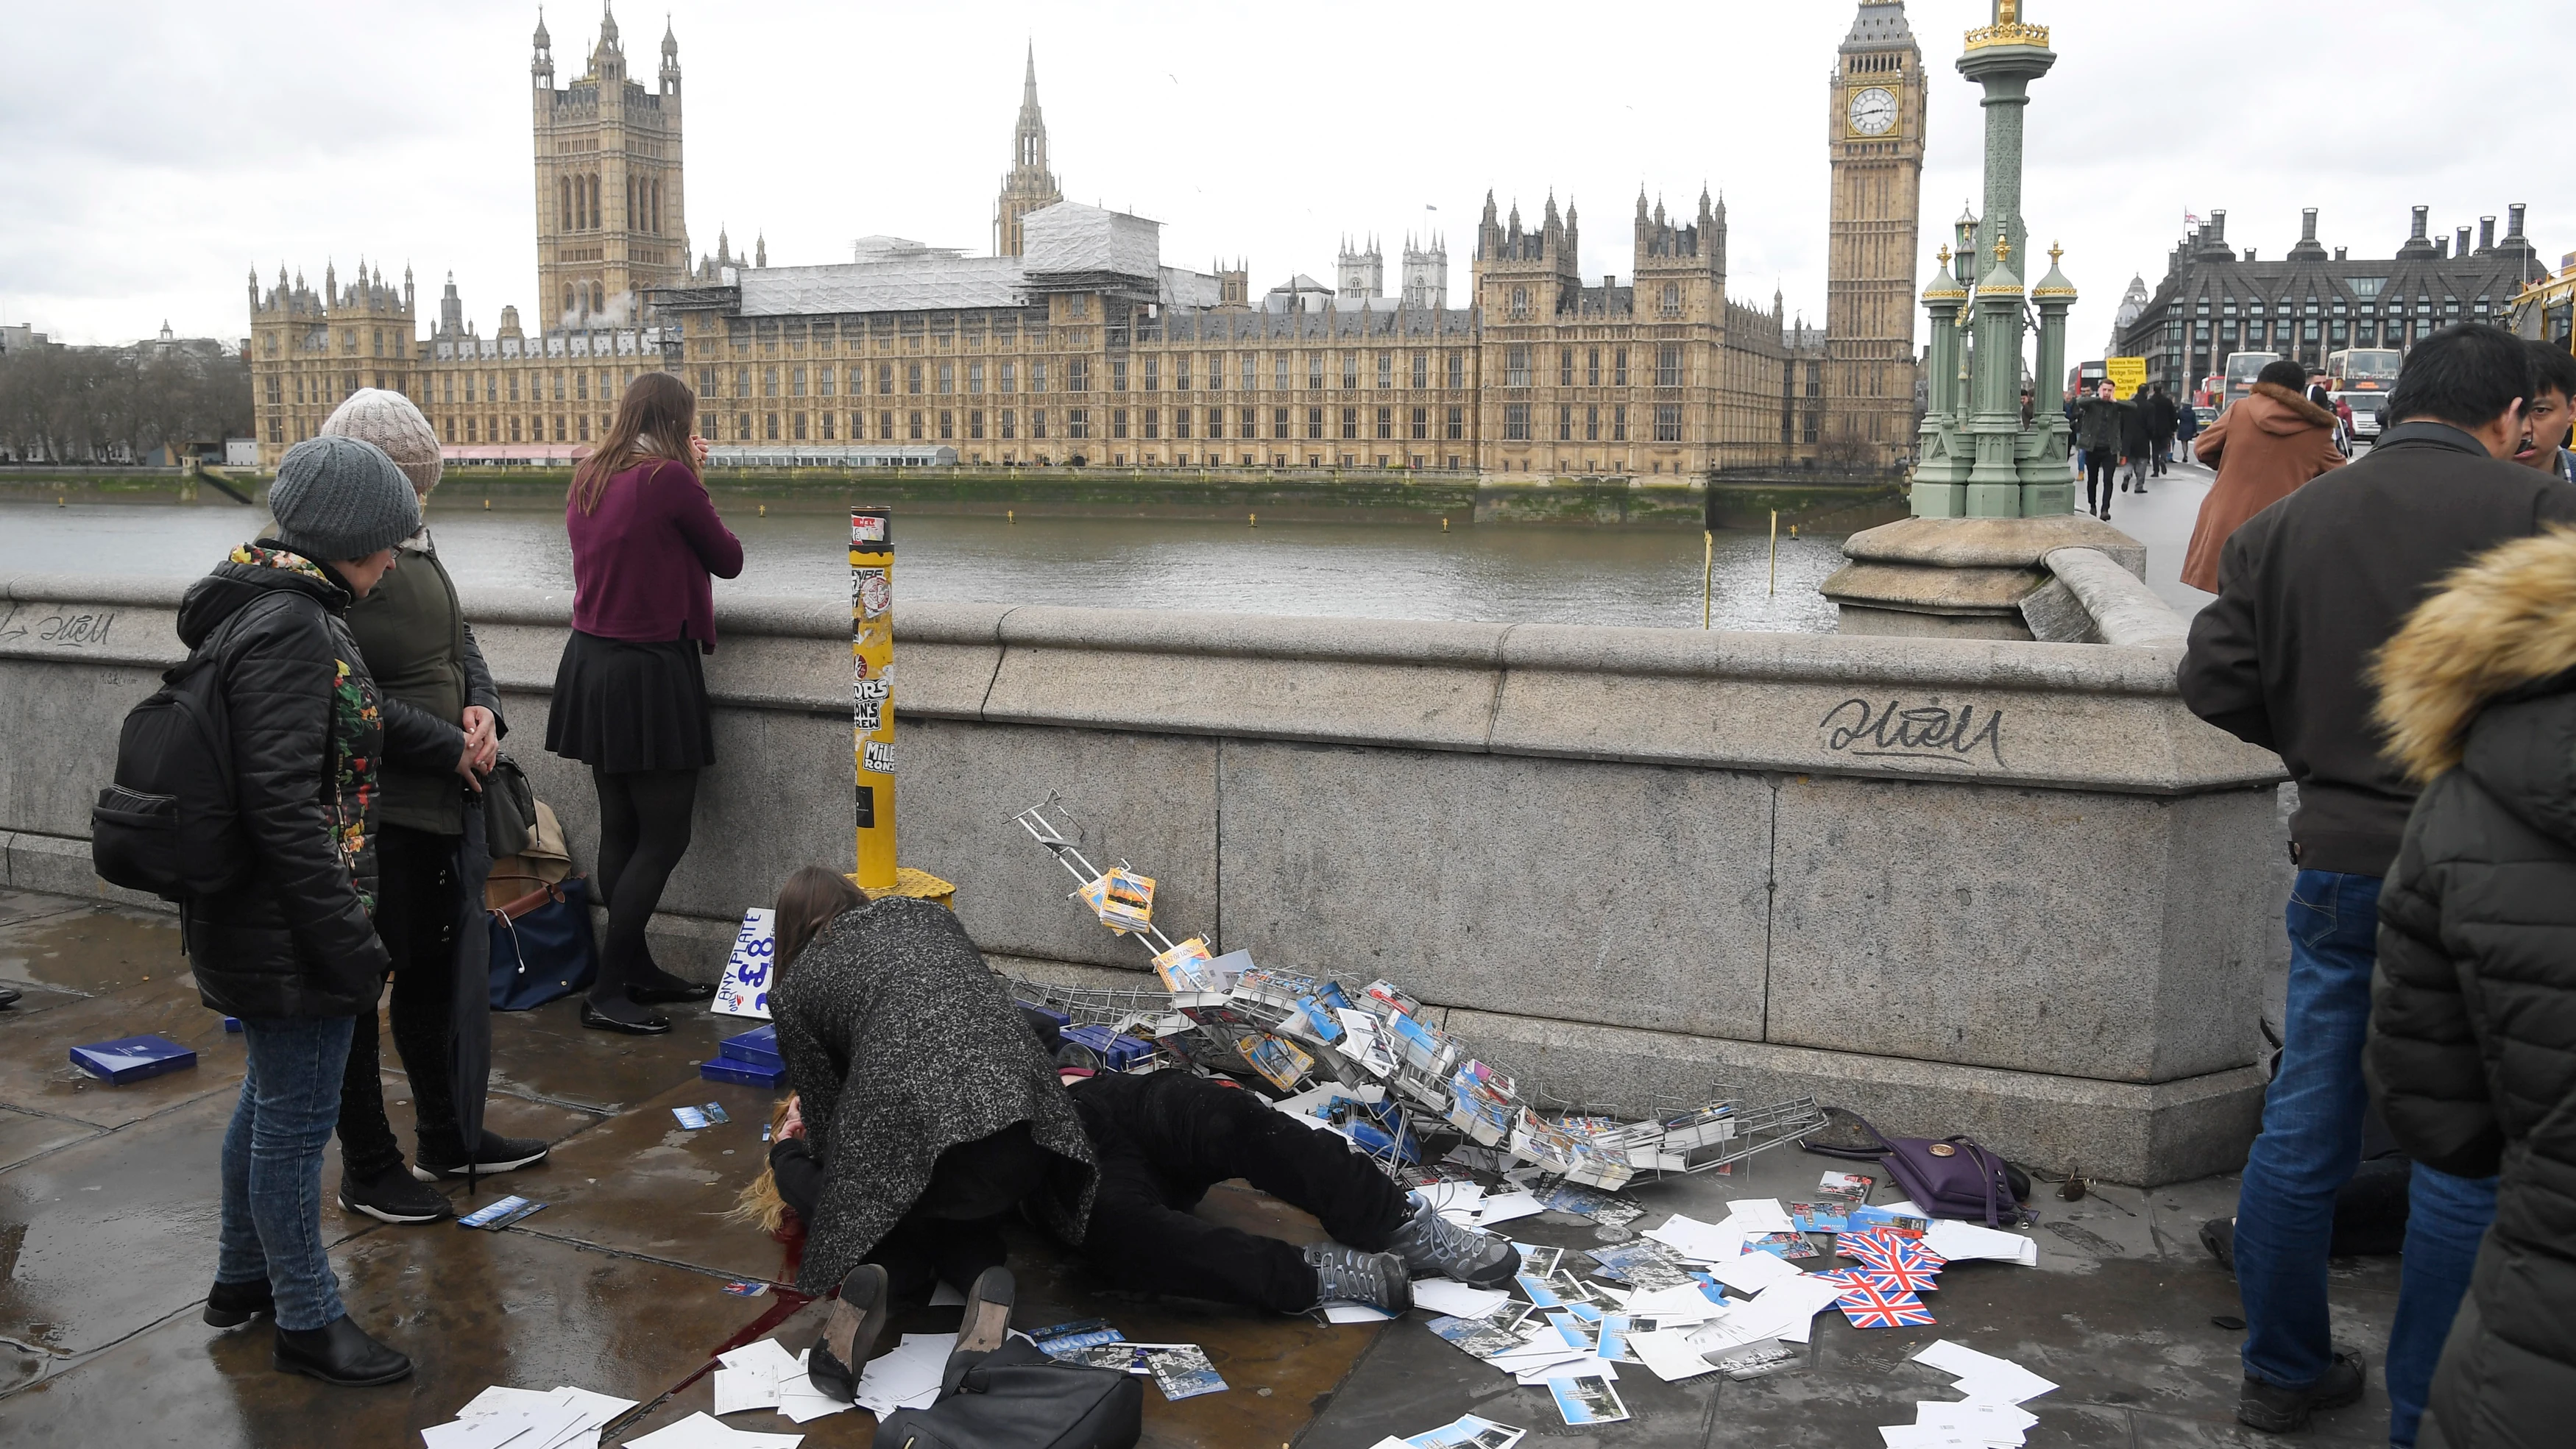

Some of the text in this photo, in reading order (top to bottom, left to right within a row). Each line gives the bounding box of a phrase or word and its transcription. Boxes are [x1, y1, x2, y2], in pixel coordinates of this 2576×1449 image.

[718, 913, 762, 1001] ANY PLATE
[738, 937, 775, 989] £8
[728, 991, 739, 1013] ONLY
[1543, 1180, 1567, 1202] LONDO
[1041, 1331, 1119, 1351] LONDON
[1478, 1319, 1522, 1343] ONDON
[1146, 1356, 1181, 1397] LONDON
